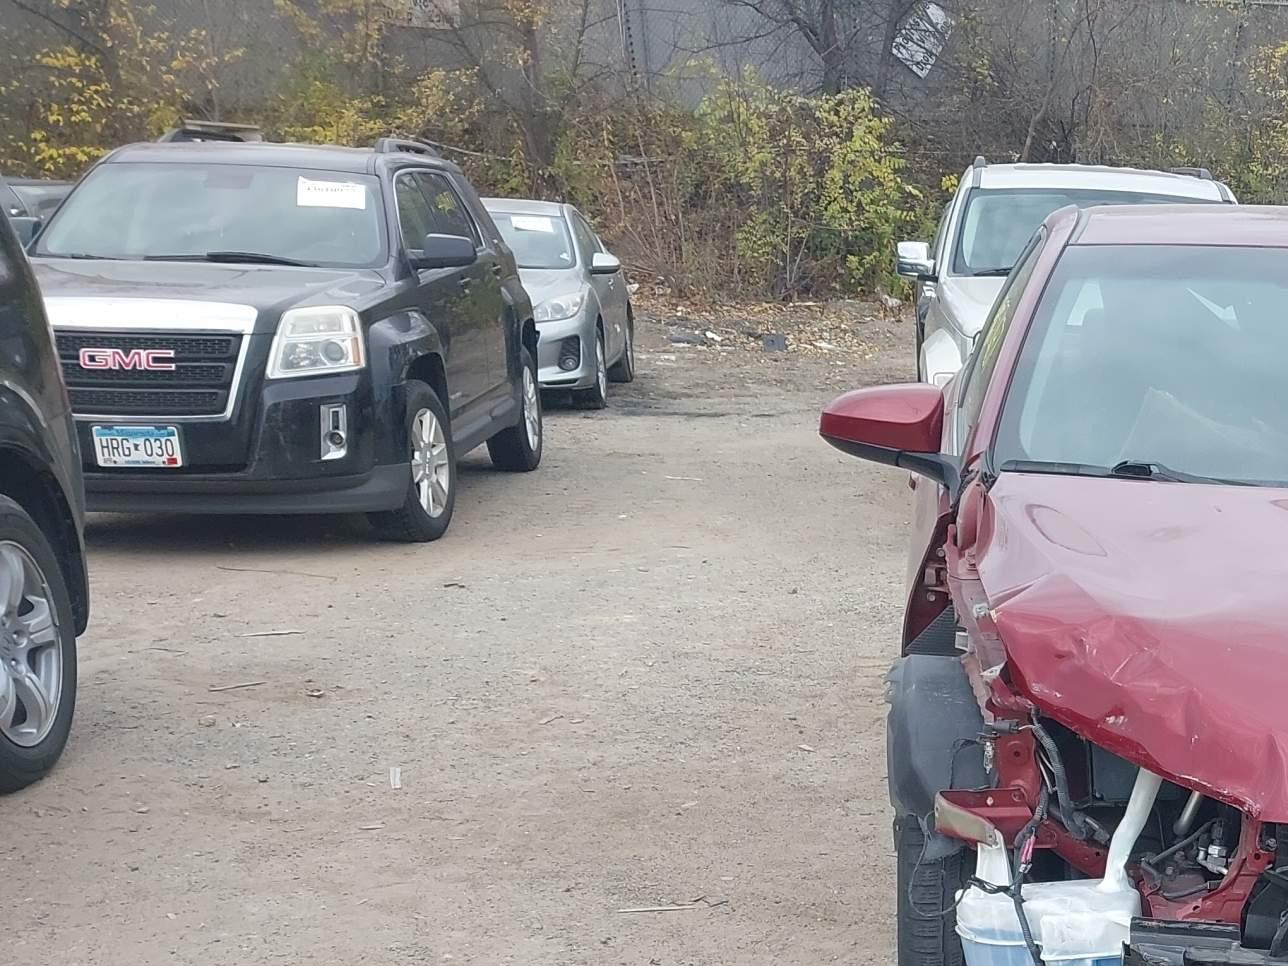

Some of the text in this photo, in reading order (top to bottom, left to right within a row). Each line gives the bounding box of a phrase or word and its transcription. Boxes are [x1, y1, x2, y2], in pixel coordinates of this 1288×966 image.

[79, 347, 176, 371] GMC
[100, 438, 175, 457] HRG 030
